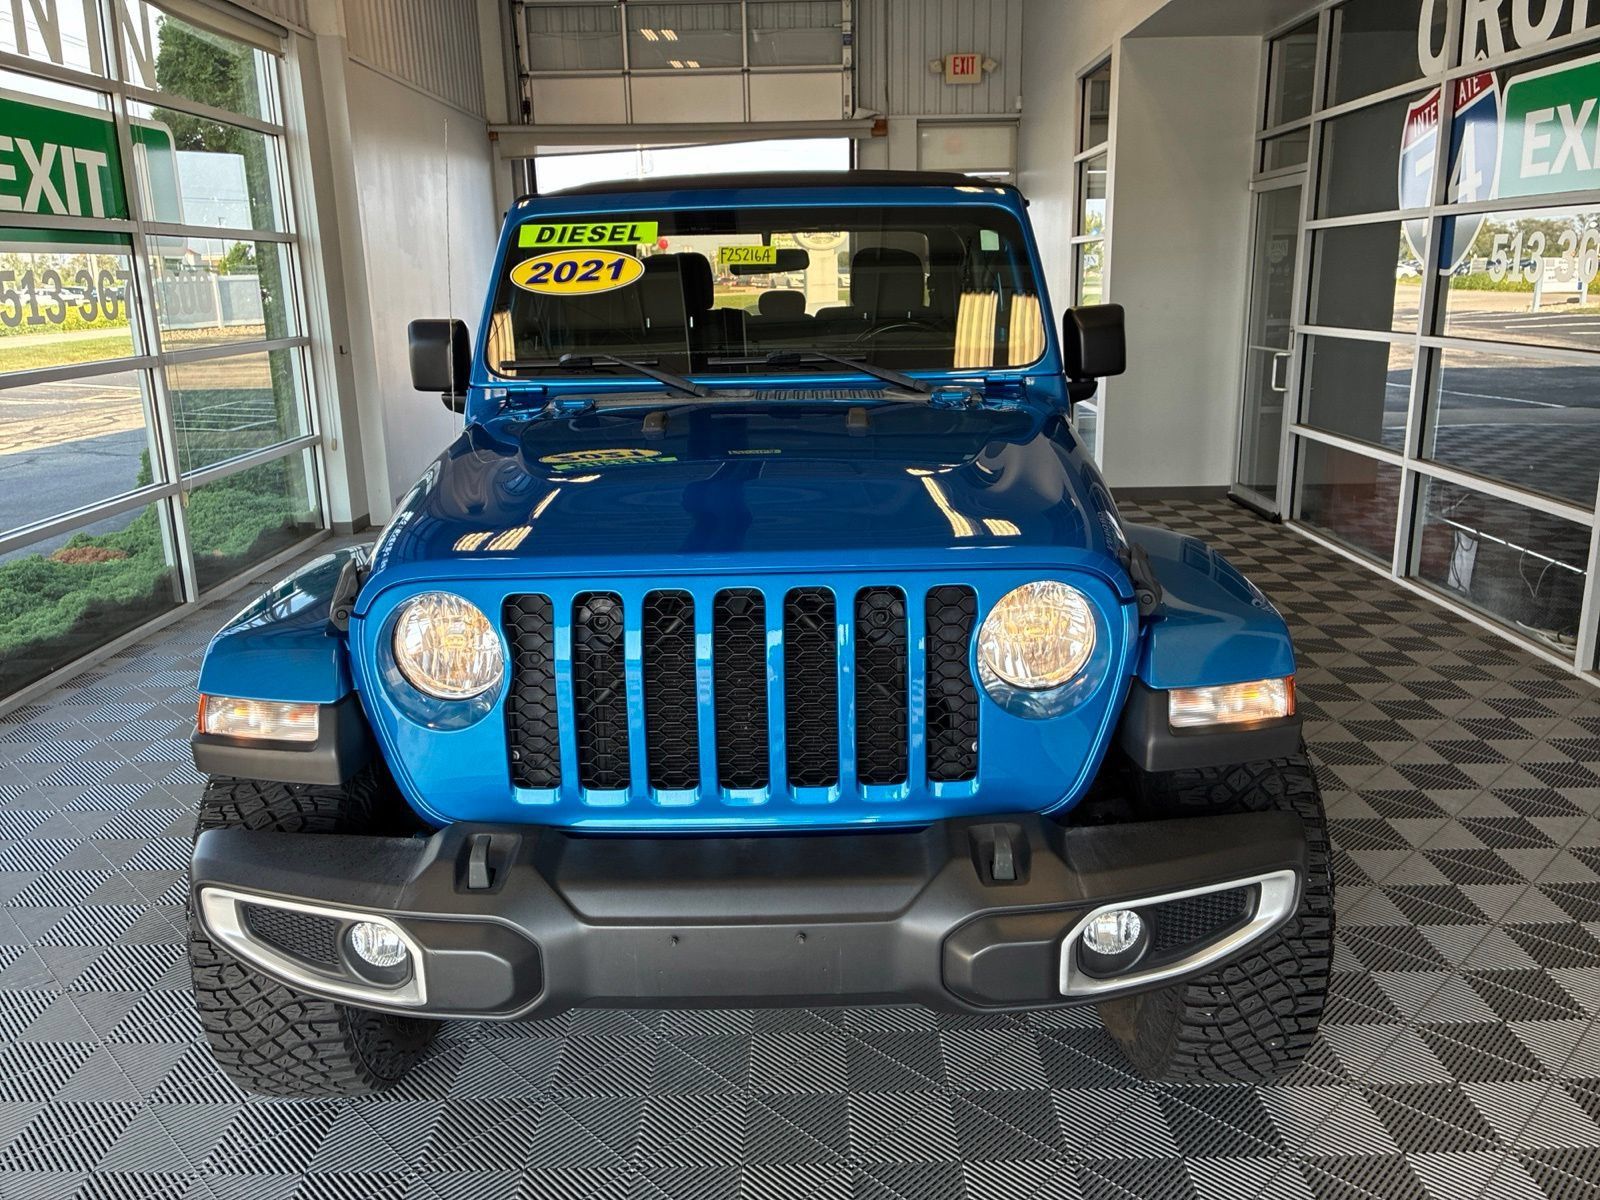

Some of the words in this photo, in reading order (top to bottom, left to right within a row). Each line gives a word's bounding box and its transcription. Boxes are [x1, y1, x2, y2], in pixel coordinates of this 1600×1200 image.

[953, 56, 976, 75] EXIT
[1413, 76, 1481, 138] INTEATE
[0, 135, 108, 218] EXIT
[534, 225, 643, 243] DIESEL
[720, 247, 771, 264] F25216A
[525, 258, 626, 285] 2021
